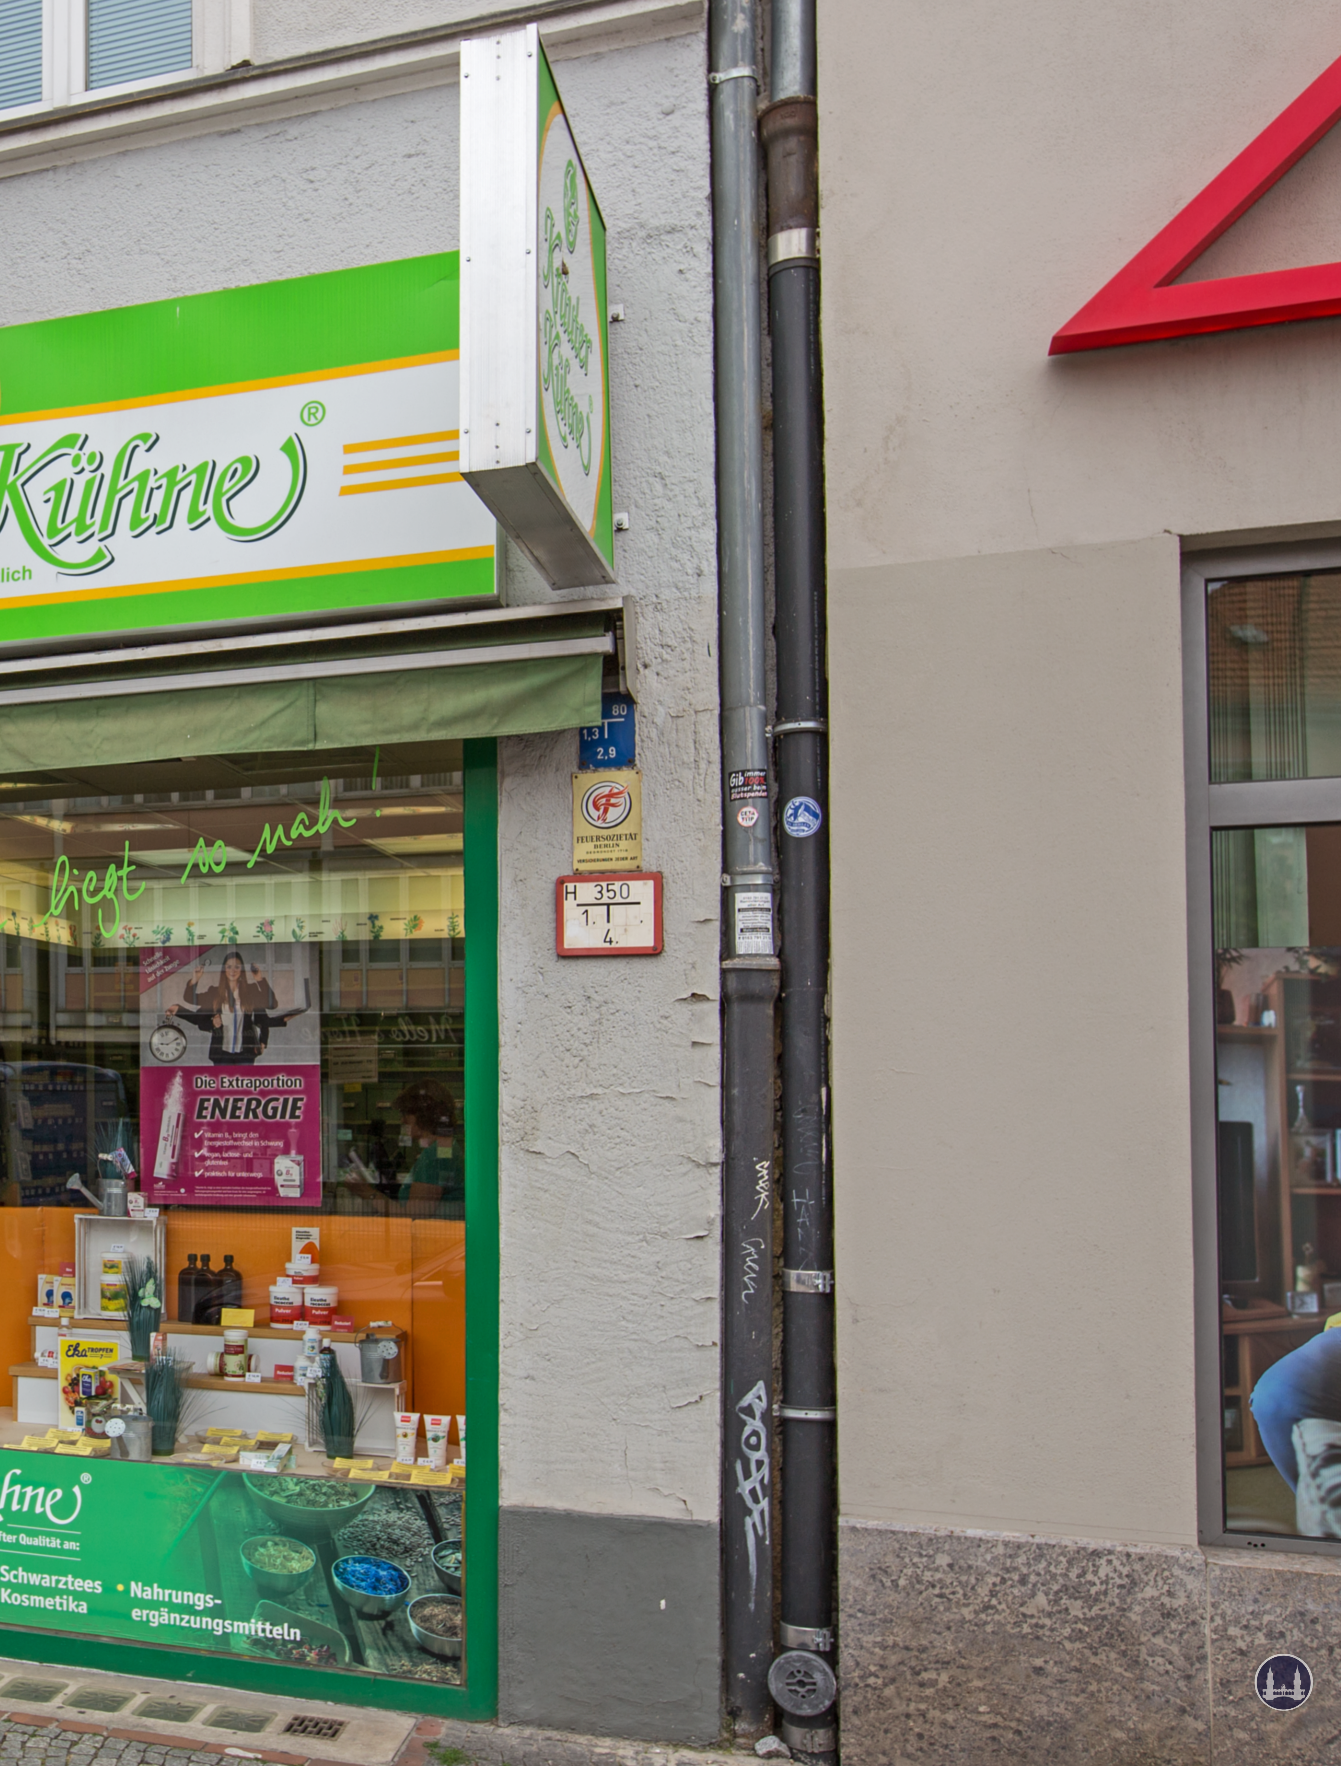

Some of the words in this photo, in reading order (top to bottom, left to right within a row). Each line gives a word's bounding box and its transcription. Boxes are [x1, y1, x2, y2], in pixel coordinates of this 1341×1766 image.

[612, 703, 627, 716] 80
[582, 727, 600, 741] 1,3
[596, 746, 617, 761] 2,9
[729, 771, 744, 787] Gib
[181, 837, 229, 883] so
[564, 885, 577, 901] H
[593, 883, 631, 901] 350
[195, 1076, 216, 1090] Die
[219, 1075, 302, 1092] Extraportion
[195, 1097, 304, 1120] ENERGIE
[204, 1131, 223, 1139] Vitamin
[233, 1131, 248, 1140] bringt
[65, 1342, 88, 1358] Eka
[19, 1532, 61, 1549] Qualität
[63, 1538, 80, 1551] an:
[0, 1565, 103, 1594] Schwarztees
[0, 1588, 88, 1615] Kosmetika
[130, 1581, 222, 1609] Nahrungs-
[131, 1607, 301, 1642] ergänzungsmitteln
